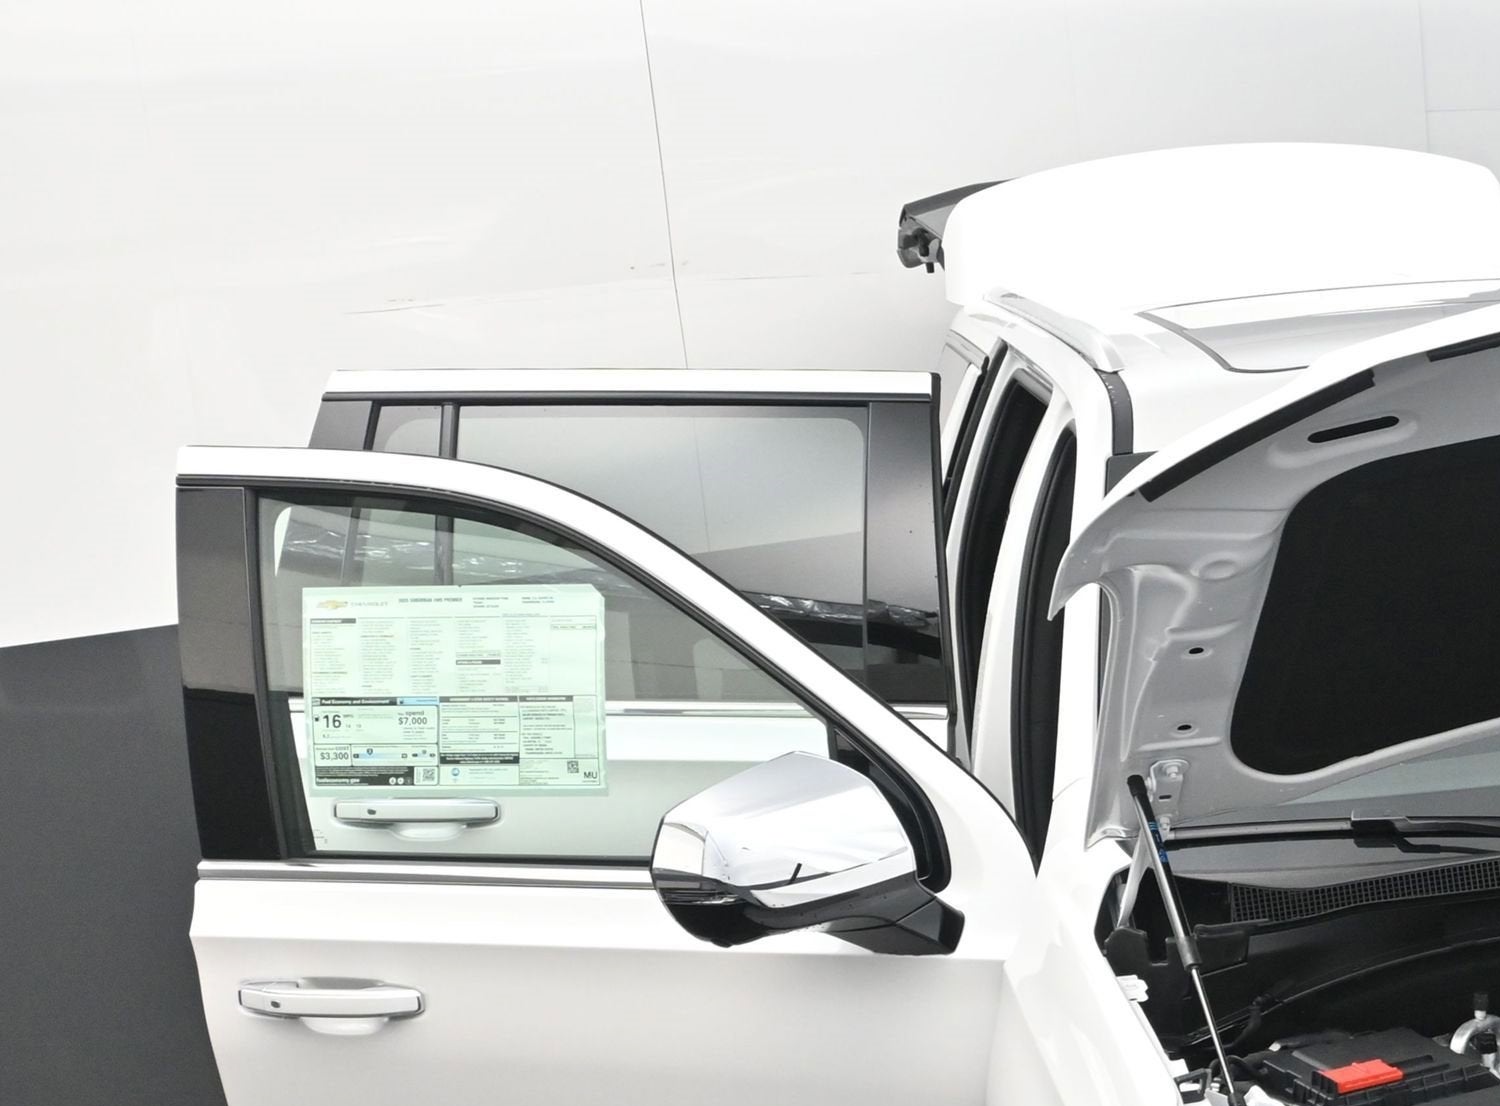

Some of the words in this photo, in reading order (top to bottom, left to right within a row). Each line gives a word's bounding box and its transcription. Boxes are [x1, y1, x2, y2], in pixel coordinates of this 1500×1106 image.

[322, 714, 342, 729] 16
[398, 717, 428, 726] $7,000
[319, 752, 349, 761] $3,300
[583, 771, 598, 779] MU
